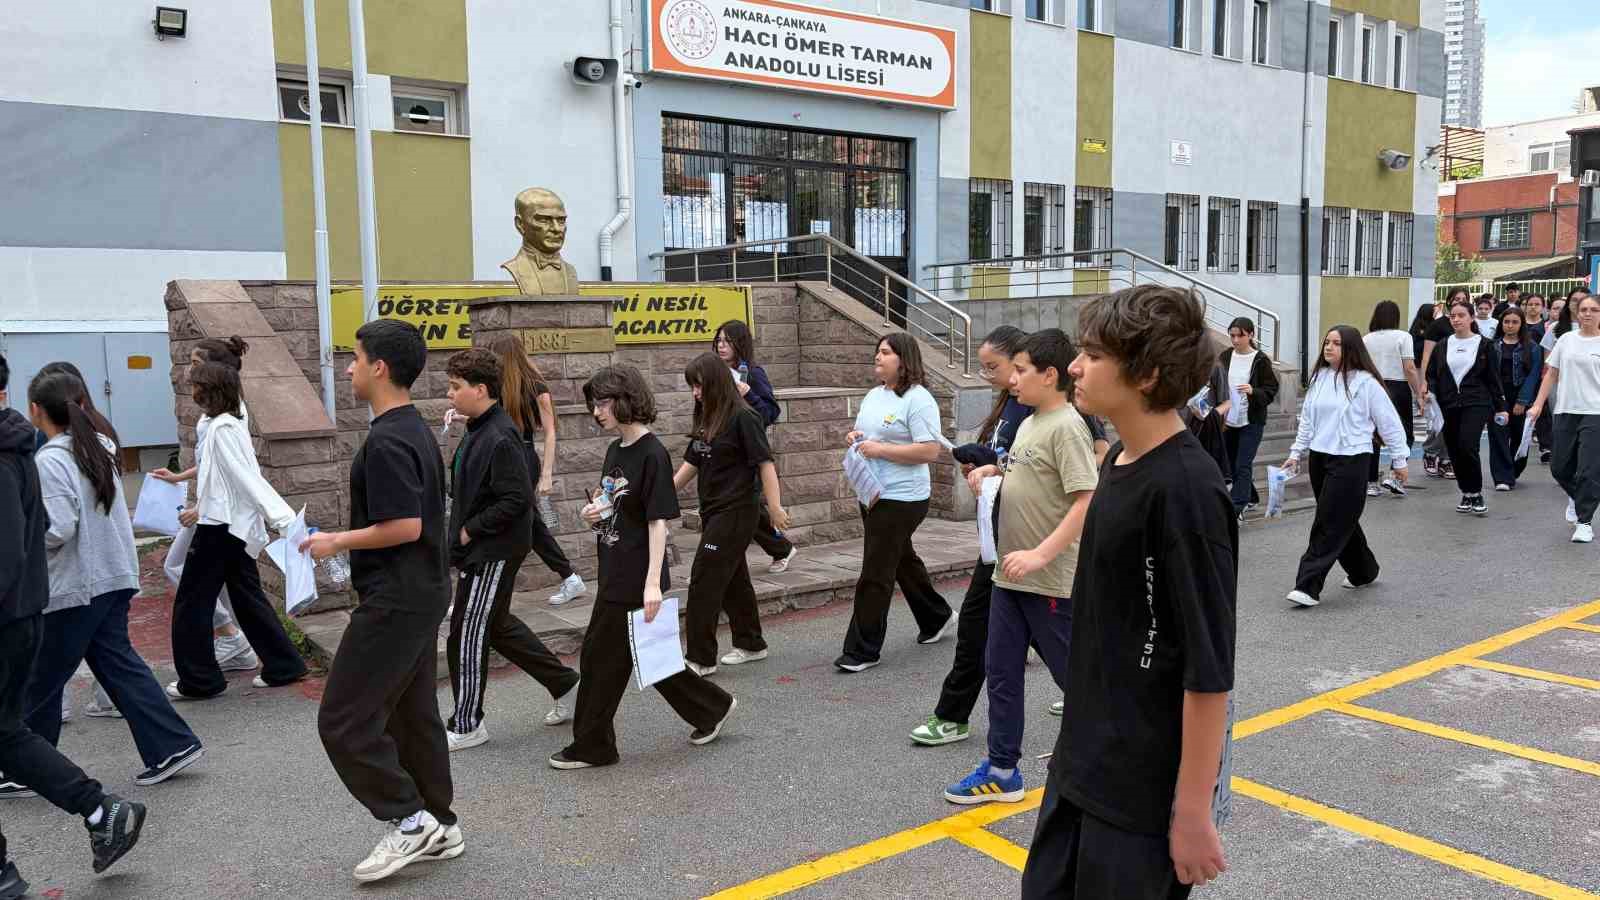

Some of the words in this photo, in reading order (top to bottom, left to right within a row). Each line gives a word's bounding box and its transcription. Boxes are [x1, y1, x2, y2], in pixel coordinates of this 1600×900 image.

[723, 7, 827, 33] ANKARA-ÇANKAYA
[724, 26, 778, 49] HACI
[784, 33, 846, 58] ÖMER
[851, 45, 933, 70] TARMAN
[724, 51, 821, 78] ANADOLU
[826, 62, 885, 86] LİSESİ
[377, 296, 470, 316] ÖĞRET
[613, 293, 640, 312] Nİ
[646, 292, 709, 311] NESİL
[417, 320, 448, 340] İN
[614, 318, 712, 336] ACAKTIR.
